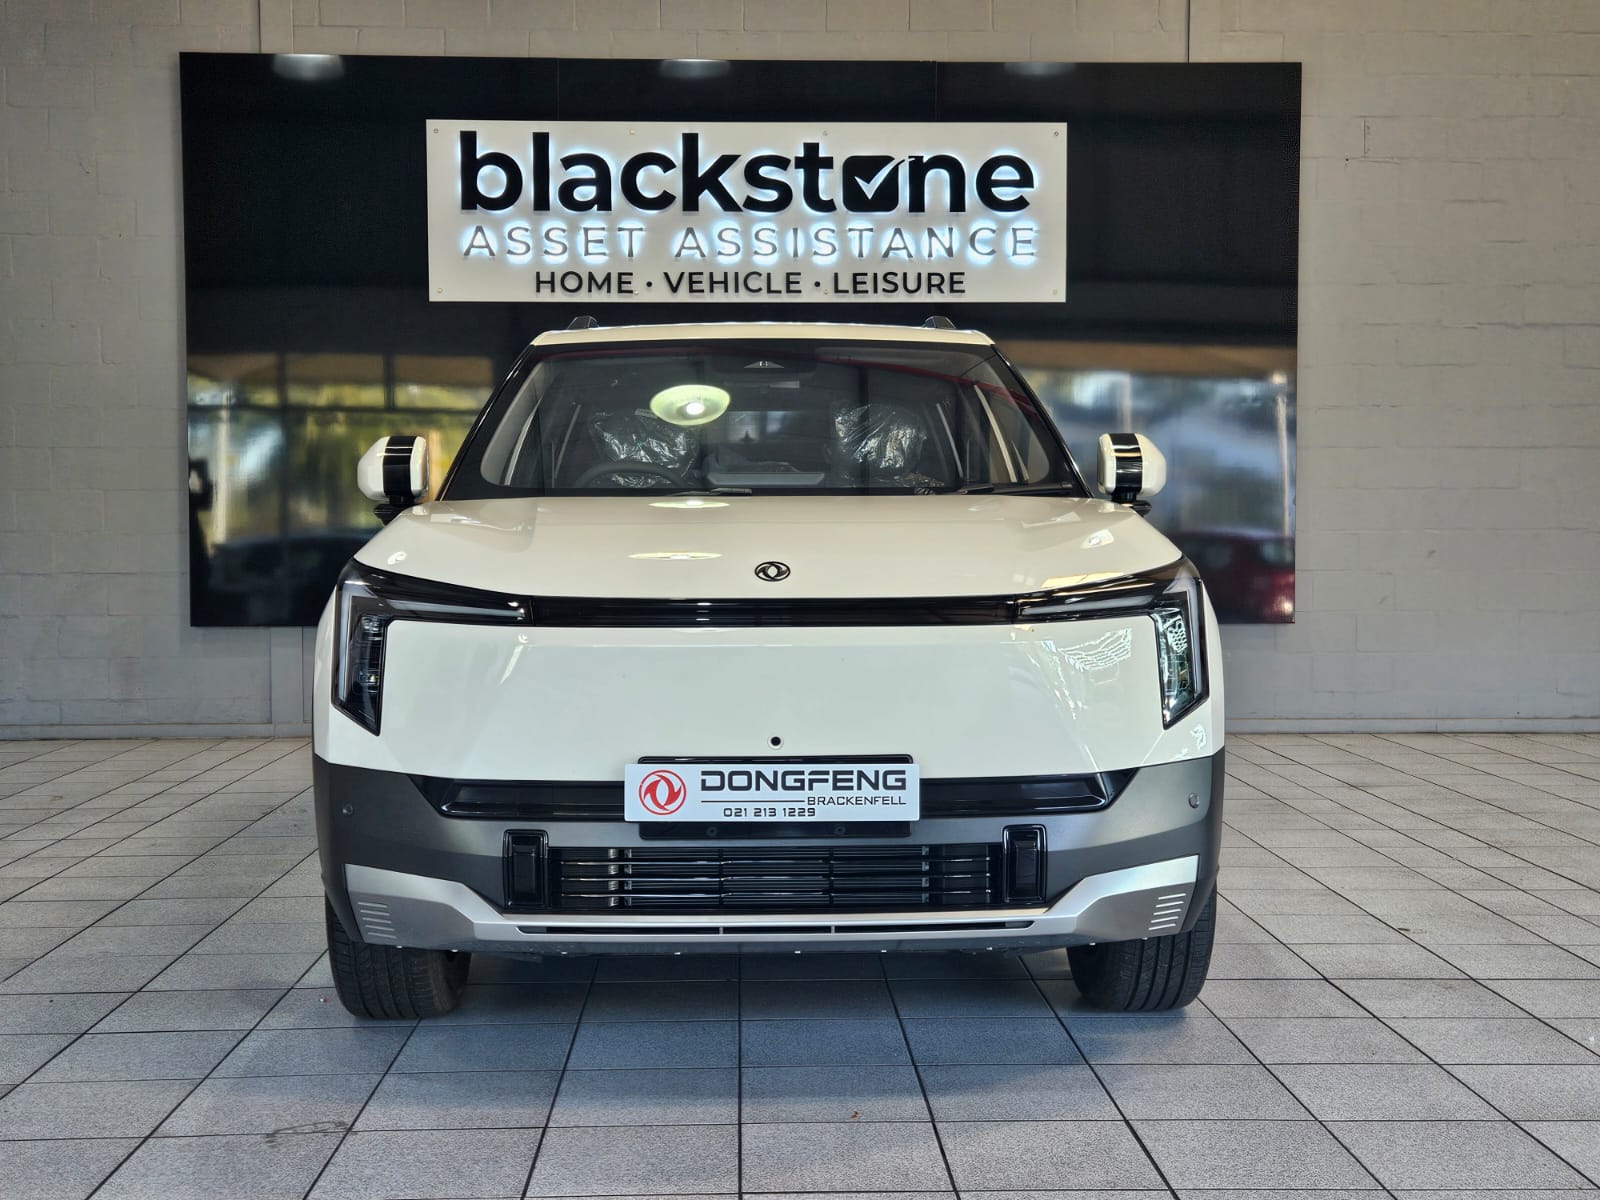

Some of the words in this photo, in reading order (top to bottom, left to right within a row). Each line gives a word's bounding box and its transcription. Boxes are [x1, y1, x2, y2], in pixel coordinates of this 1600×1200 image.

[463, 225, 645, 259] ASSET
[673, 226, 1037, 259] ASSISTANCE
[535, 270, 635, 294] HOME
[663, 271, 803, 294] VEHICLE
[833, 271, 966, 294] LEISURE
[700, 769, 907, 791] DONGFENG
[807, 795, 907, 806] BRACKENFELL
[723, 807, 749, 818] 021
[753, 807, 777, 818] 213
[782, 807, 816, 818] 1229
